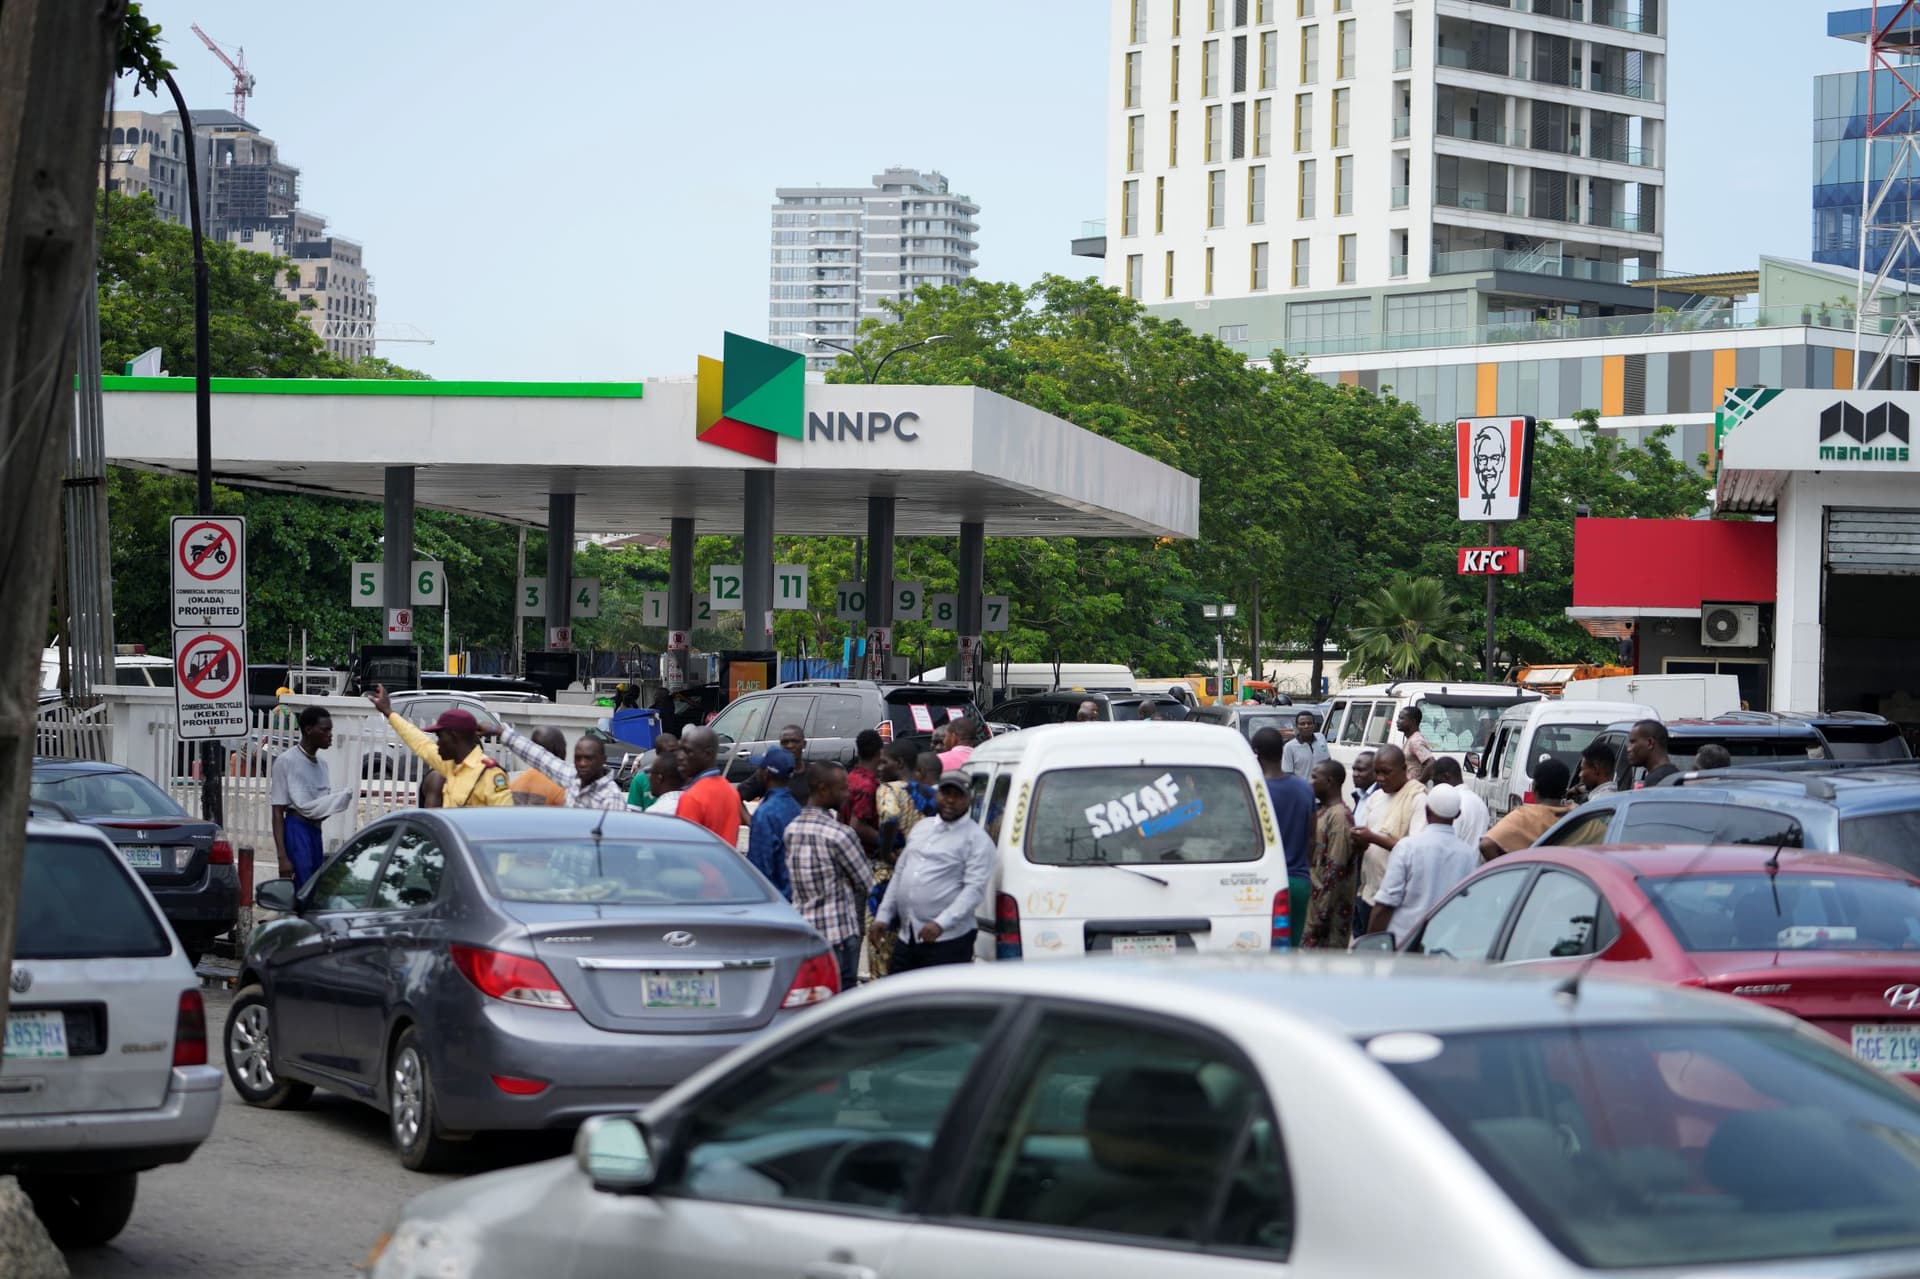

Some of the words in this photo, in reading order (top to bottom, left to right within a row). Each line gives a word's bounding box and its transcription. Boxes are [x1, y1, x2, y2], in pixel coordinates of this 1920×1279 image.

[809, 411, 920, 441] NNPC
[1463, 550, 1505, 572] KFC
[360, 572, 375, 596] 5
[418, 570, 434, 595] 6
[713, 576, 741, 599] 12
[779, 575, 802, 598] 11
[188, 596, 224, 604] (OKADA)
[525, 586, 539, 608] 3
[576, 587, 591, 608] 4
[838, 592, 865, 612] 10
[900, 590, 915, 611] 9
[178, 607, 240, 615] PROHIBITED
[652, 599, 660, 618] 1
[698, 602, 711, 620] 2
[938, 602, 953, 620] 8
[987, 604, 1002, 622] 7
[736, 680, 760, 690] PLACE
[181, 703, 215, 711] COMMERCIAL
[216, 701, 243, 709] TRICYCLES
[193, 710, 230, 719] (KEKE)
[182, 717, 244, 726] PROHIBITED
[1220, 878, 1269, 886] EVERY
[1732, 983, 1793, 995] ACCENT
